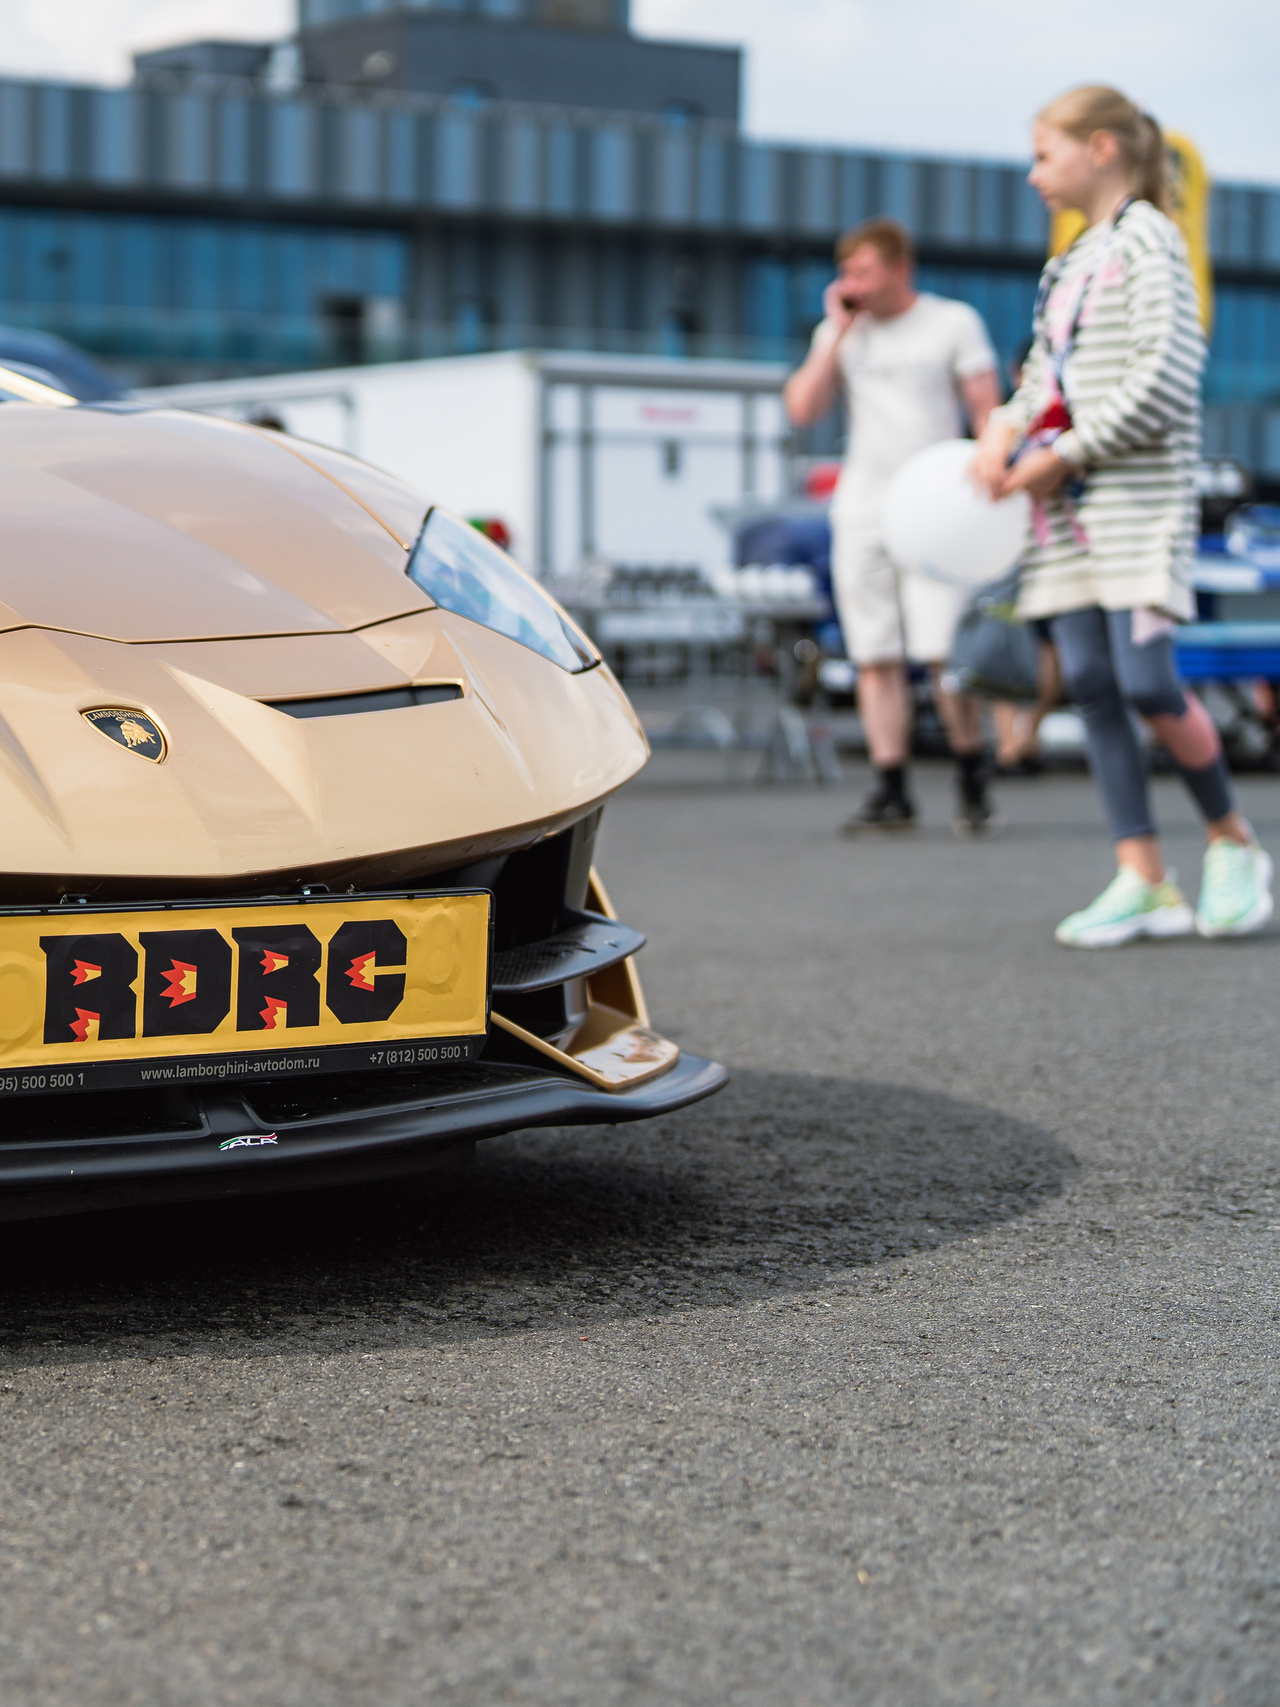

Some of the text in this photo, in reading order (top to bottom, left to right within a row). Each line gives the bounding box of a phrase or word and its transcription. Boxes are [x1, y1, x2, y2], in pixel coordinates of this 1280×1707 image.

[87, 710, 148, 721] LAMBORGHINI
[39, 919, 407, 1044] RDRC
[369, 1045, 469, 1065] +7 (812) 500 500 1
[140, 1057, 320, 1080] www.lamborghini-avtodom.ru
[21, 1075, 46, 1090] 500
[49, 1074, 74, 1088] 500
[78, 1072, 84, 1086] 1
